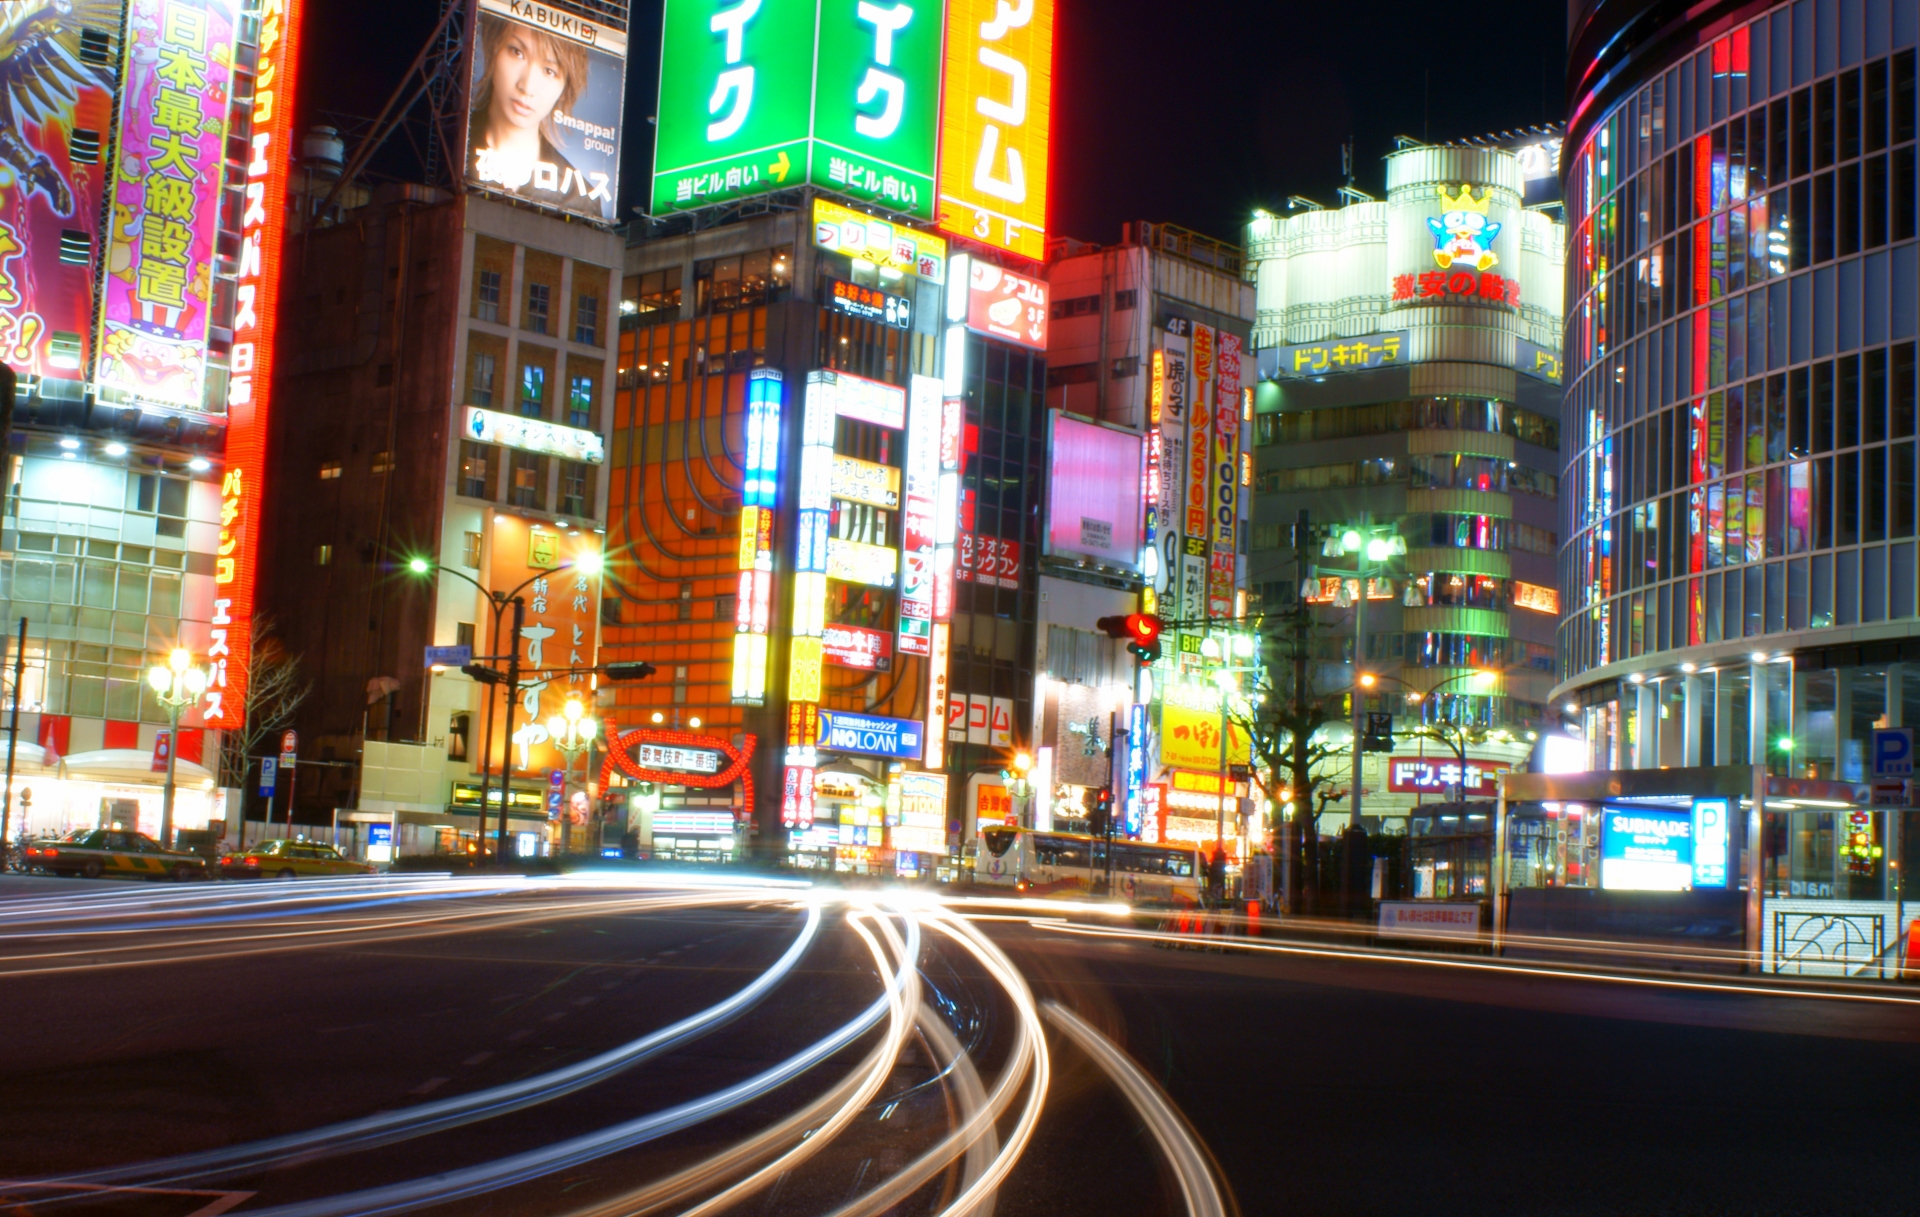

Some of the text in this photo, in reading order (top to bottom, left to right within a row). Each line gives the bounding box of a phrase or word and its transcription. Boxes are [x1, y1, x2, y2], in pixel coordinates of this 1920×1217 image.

[553, 109, 615, 141] Smappa!
[138, 3, 211, 309] 日本最大級設置
[584, 137, 614, 156] group
[676, 163, 759, 202] 当ビル向い
[829, 157, 918, 203] 当ビル向い
[235, 132, 271, 331] エスパス
[973, 209, 1023, 246] 3F
[861, 250, 898, 267] さん
[1003, 273, 1044, 305] アコム
[1392, 271, 1521, 308] 激安の殿堂
[1027, 307, 1045, 324] 3F
[1167, 318, 1187, 335] 4F
[1167, 359, 1186, 417] 虎の子
[962, 534, 1010, 555] カラオケ
[1187, 539, 1205, 556] 5F
[956, 568, 969, 580] 5F
[203, 467, 242, 721] パチンコ エスパス
[573, 576, 588, 613] 名代
[511, 575, 557, 771] 新宿 すずや
[949, 700, 1009, 731] アコム
[832, 728, 897, 753] NOLOAN
[949, 731, 960, 741] 3F
[641, 746, 717, 771] 歌舞伎町一番街
[1876, 731, 1910, 773] P
[1612, 816, 1690, 839] SUBNADE
[1702, 808, 1718, 839] P
